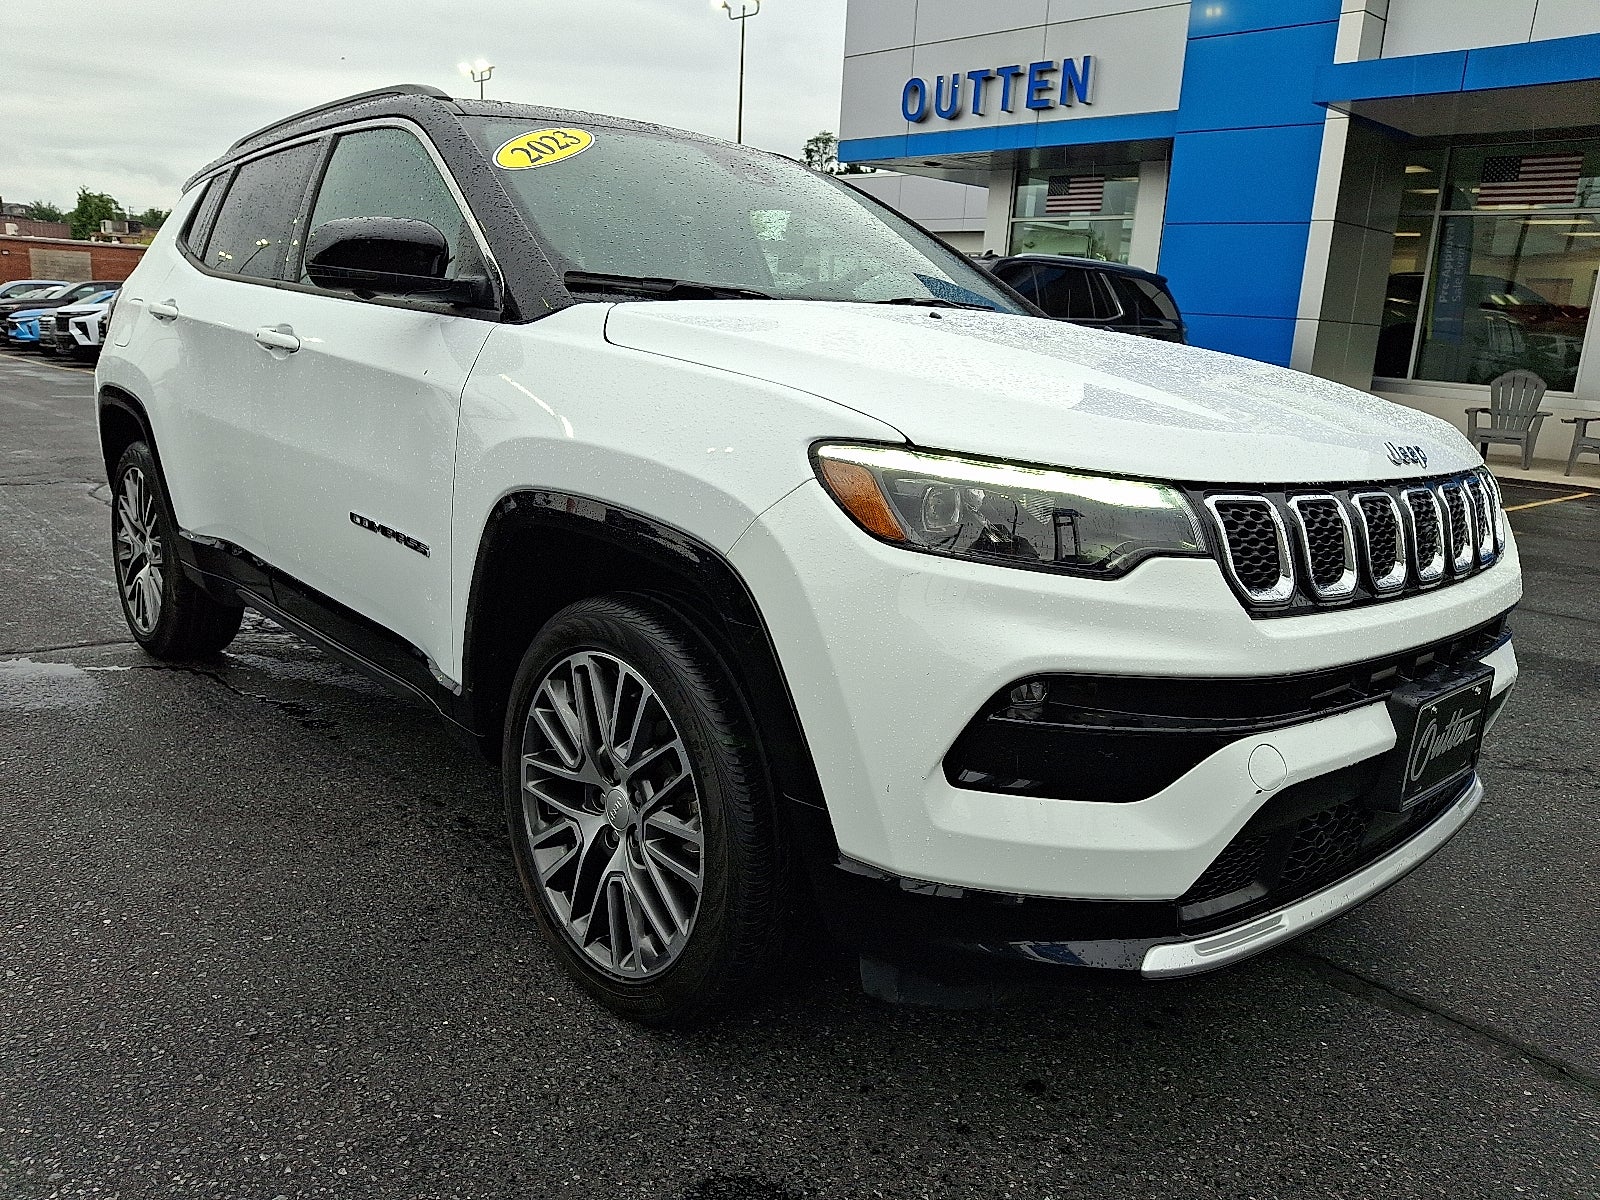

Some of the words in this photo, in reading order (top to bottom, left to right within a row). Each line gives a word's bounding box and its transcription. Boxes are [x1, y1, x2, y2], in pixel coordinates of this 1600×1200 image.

[902, 55, 1096, 123] OUTTEN
[511, 131, 581, 163] 2023
[1439, 223, 1455, 303] Pre-Approval
[1452, 277, 1462, 302] Sale
[1384, 441, 1428, 469] Jeep
[349, 511, 430, 558] COMPASS
[1411, 708, 1481, 781] Outten
